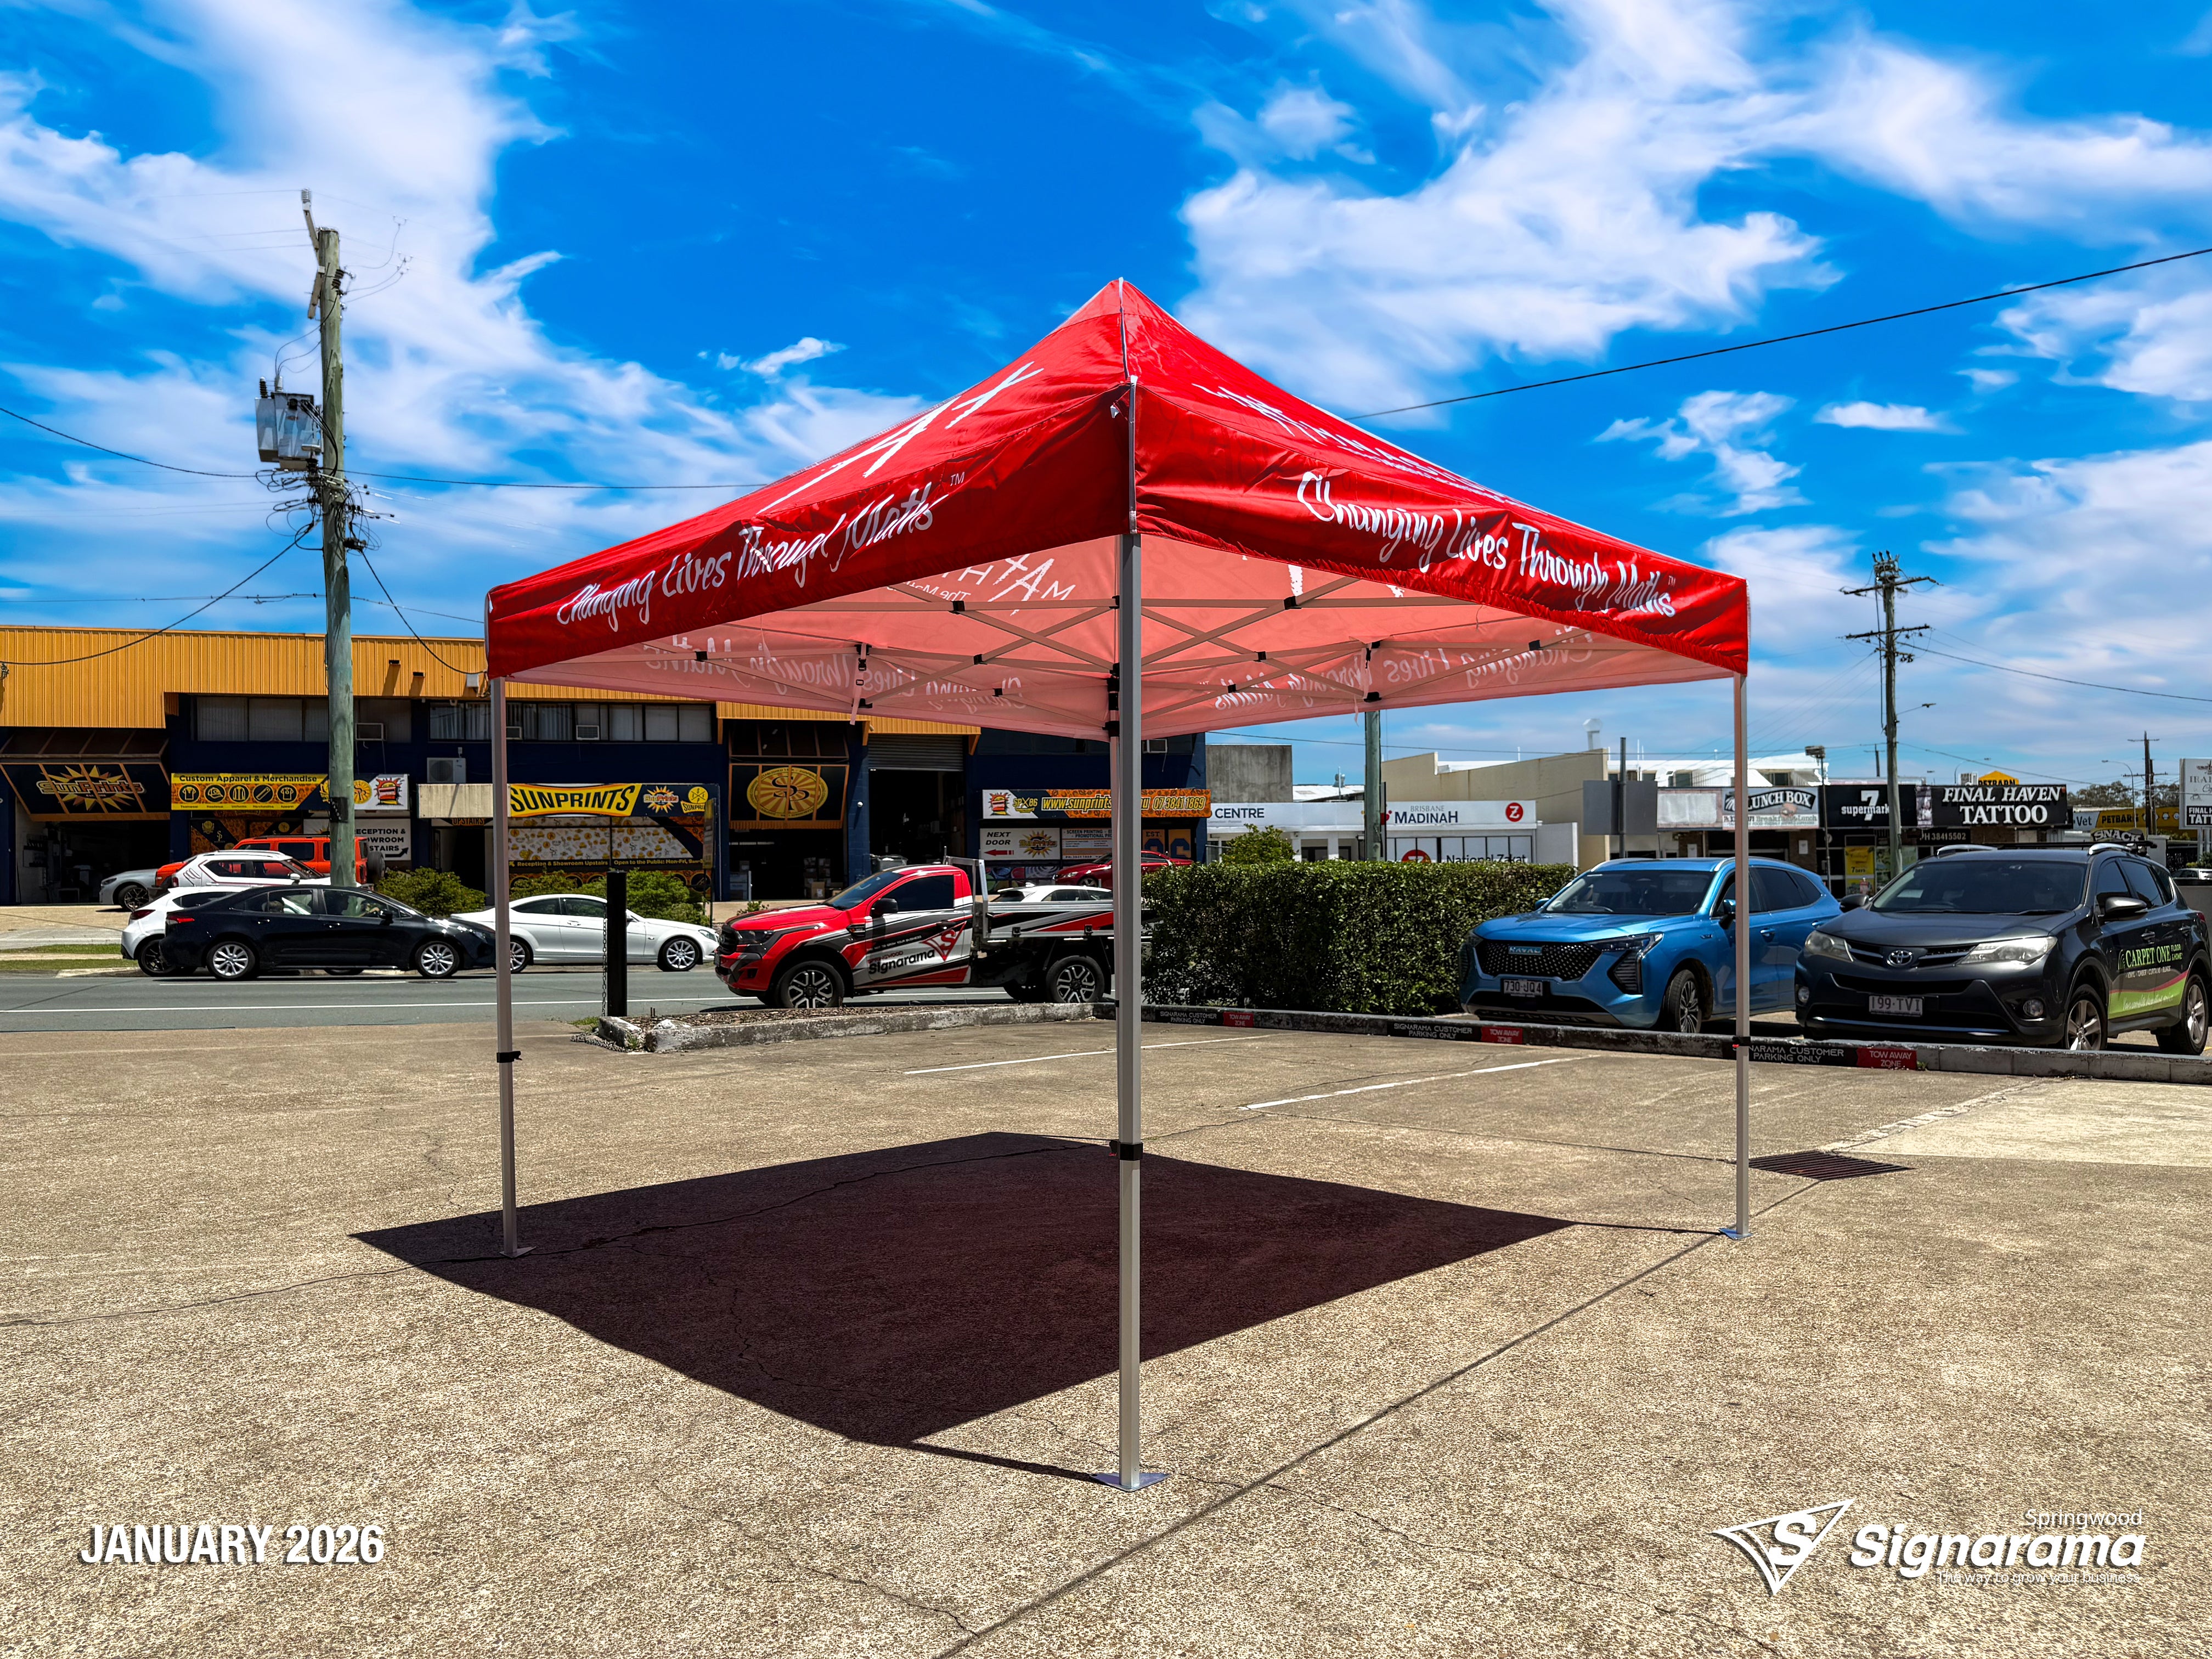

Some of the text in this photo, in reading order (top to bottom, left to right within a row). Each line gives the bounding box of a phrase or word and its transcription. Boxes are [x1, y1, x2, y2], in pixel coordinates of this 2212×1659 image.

[1297, 471, 1443, 574] Changing
[1445, 508, 1510, 569] Lives
[1511, 522, 1610, 611] Through
[1599, 560, 1677, 618] Maths
[557, 569, 656, 632] Changing
[662, 551, 732, 597] Lives
[738, 513, 847, 589] Through
[511, 785, 635, 812] SUNPRINTS
[1785, 791, 1812, 807] BOX
[1942, 787, 2061, 802] FINAL HAVEN
[683, 803, 704, 811] SUNPRI
[1153, 797, 1164, 810] 07
[1165, 797, 1185, 810] 3841
[1186, 797, 1205, 810] 1869
[1841, 804, 1890, 815] supermark
[1215, 808, 1265, 819] CENTRE
[1394, 810, 1458, 824] MADINAH
[1960, 805, 2048, 825] TATTOO
[2188, 814, 2212, 824] TATT
[2076, 815, 2092, 826] Vet
[2093, 829, 2142, 841] SNACK
[868, 949, 935, 974] Signarama
[2125, 947, 2155, 968] CARPET
[2156, 945, 2171, 964] ONE
[1394, 1023, 1472, 1034] SIGNARAMA CUSTOMER
[1408, 1030, 1457, 1040] PARKING ONLY
[1748, 1045, 1845, 1057] NARAMA CUSTOMER
[1869, 1050, 1912, 1060] TOW AWAY
[1753, 1052, 1822, 1064] PARKING ONLY
[1881, 1059, 1902, 1068] ZONE
